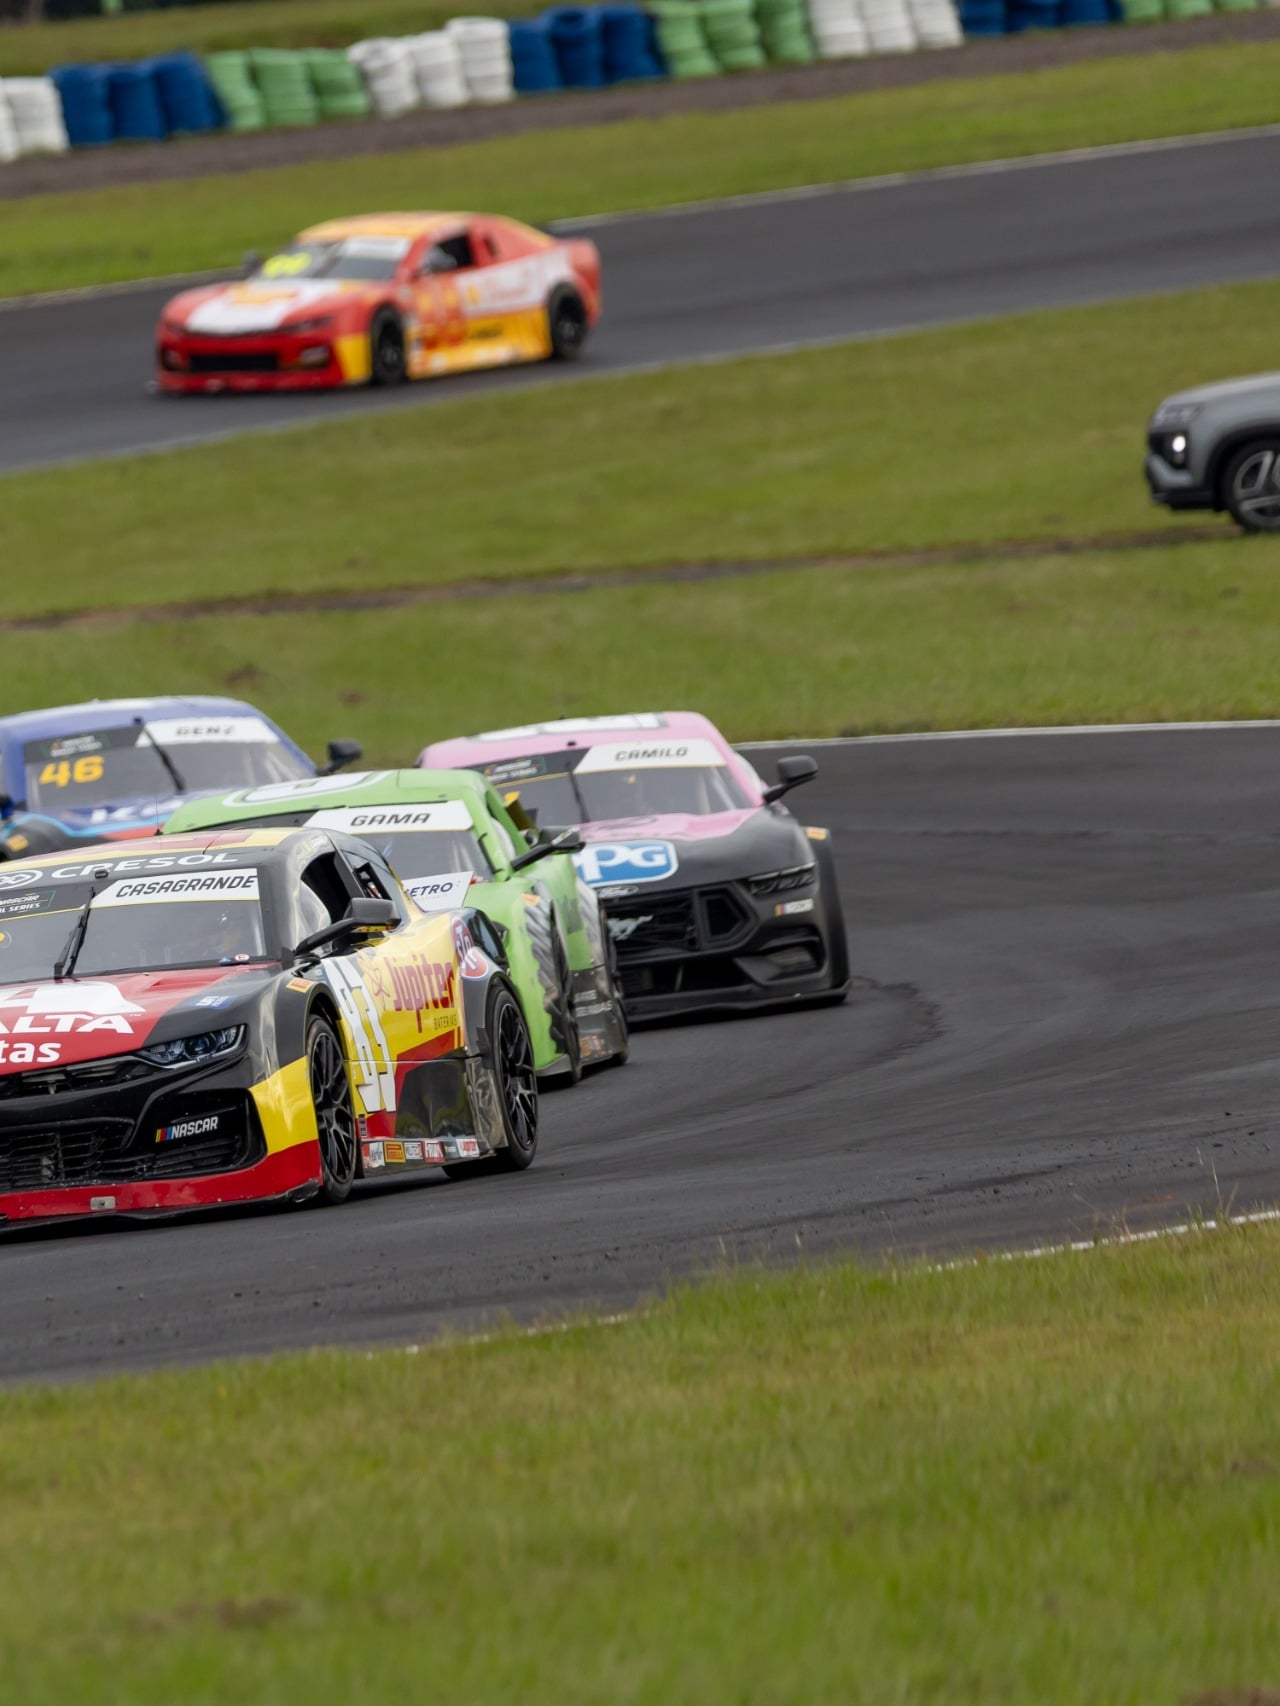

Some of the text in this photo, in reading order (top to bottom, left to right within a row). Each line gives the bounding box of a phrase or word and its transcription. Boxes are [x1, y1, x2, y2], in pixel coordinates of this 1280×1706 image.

[614, 746, 689, 761] CAMILO
[39, 755, 105, 788] 46
[351, 813, 431, 827] GAMA
[52, 852, 239, 879] CRESOL
[116, 874, 258, 898] CASAGRANDE
[406, 882, 454, 897] ETRO
[10, 902, 41, 912] SERIES
[384, 953, 456, 1034] Jupiter
[170, 1116, 219, 1140] NASCAR
